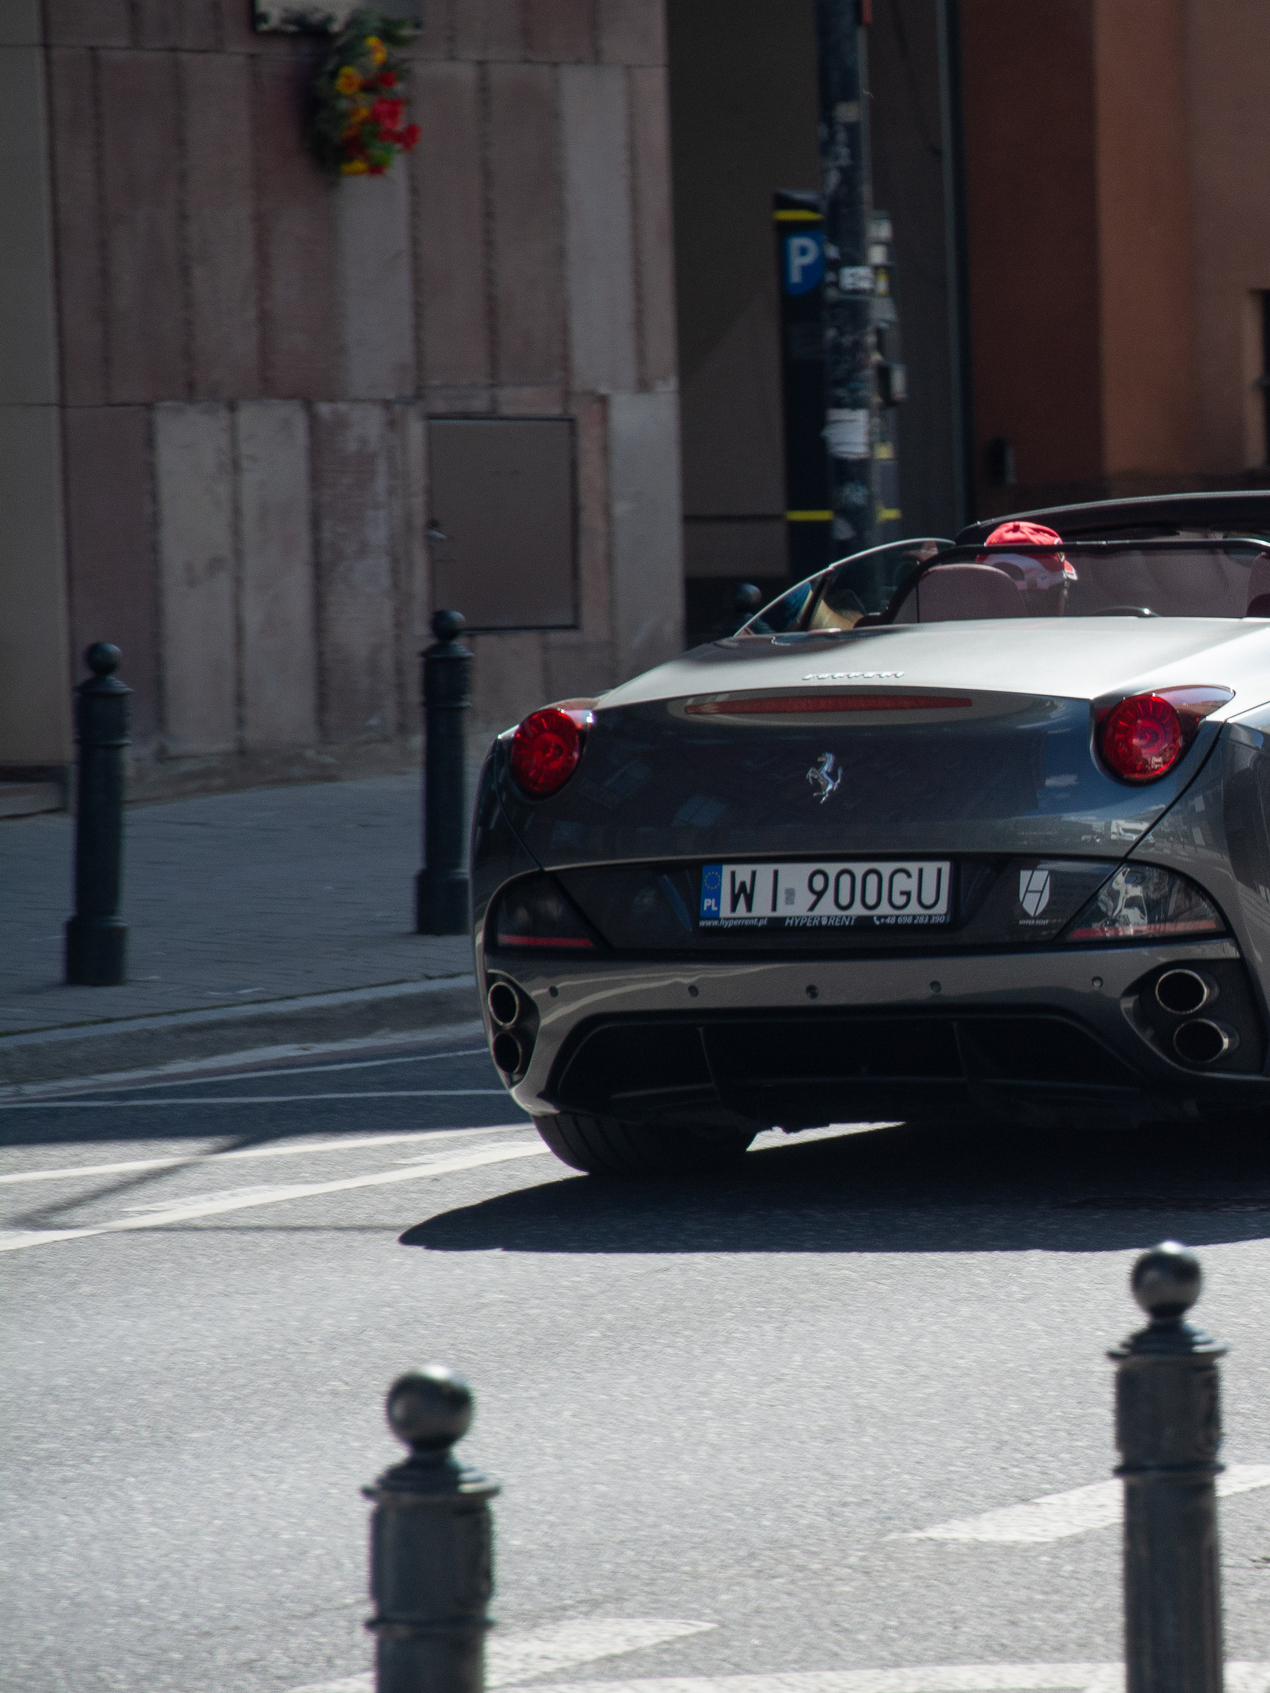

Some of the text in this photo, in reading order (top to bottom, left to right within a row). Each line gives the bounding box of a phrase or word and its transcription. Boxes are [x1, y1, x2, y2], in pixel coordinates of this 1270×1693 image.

[788, 236, 818, 283] P
[806, 867, 943, 912] 900GU
[703, 898, 718, 911] PL
[699, 917, 768, 928] www.hyperrent.pl
[785, 915, 858, 927] HYPER RENT
[897, 915, 912, 924] 698
[914, 915, 929, 924] 283
